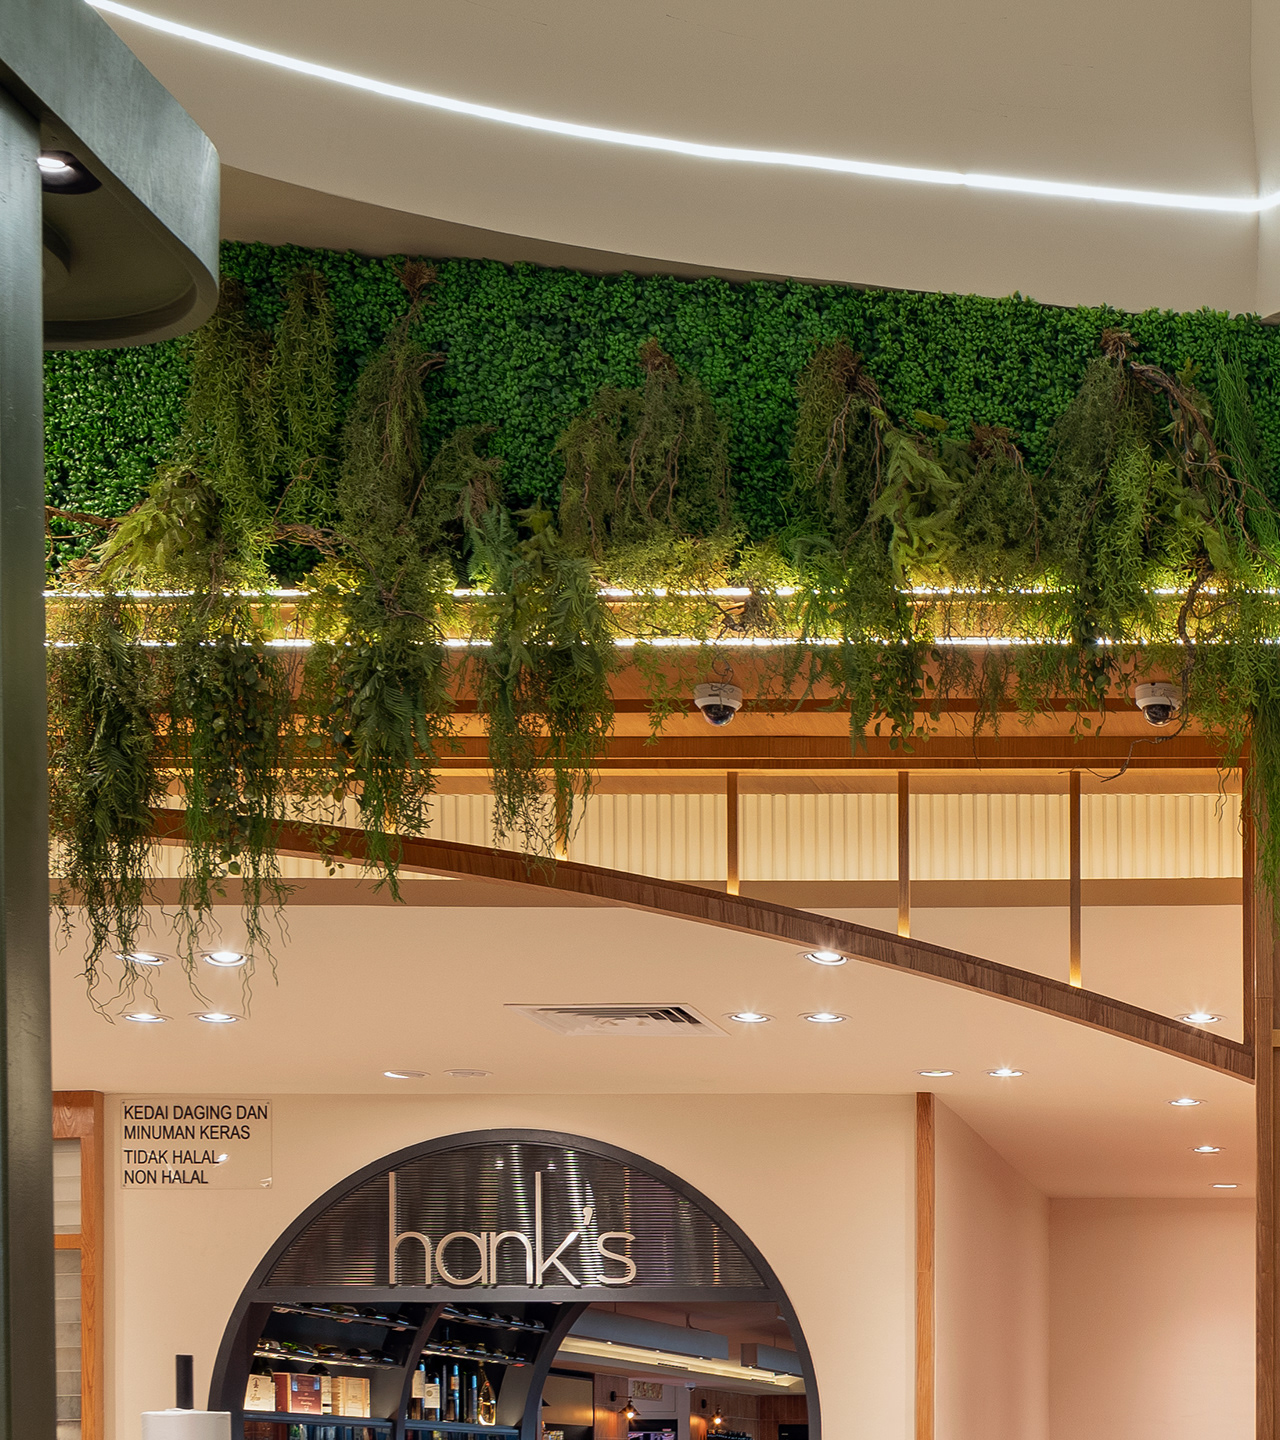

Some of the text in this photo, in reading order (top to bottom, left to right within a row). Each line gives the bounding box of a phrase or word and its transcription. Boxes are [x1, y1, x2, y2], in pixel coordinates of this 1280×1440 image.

[124, 1105, 268, 1120] KEDAI DAGING DAN
[124, 1125, 251, 1140] MINUMAN KERAS
[123, 1149, 220, 1164] TIDAK HALAL
[124, 1169, 209, 1184] NON HALAL
[388, 1171, 637, 1286] hank's
